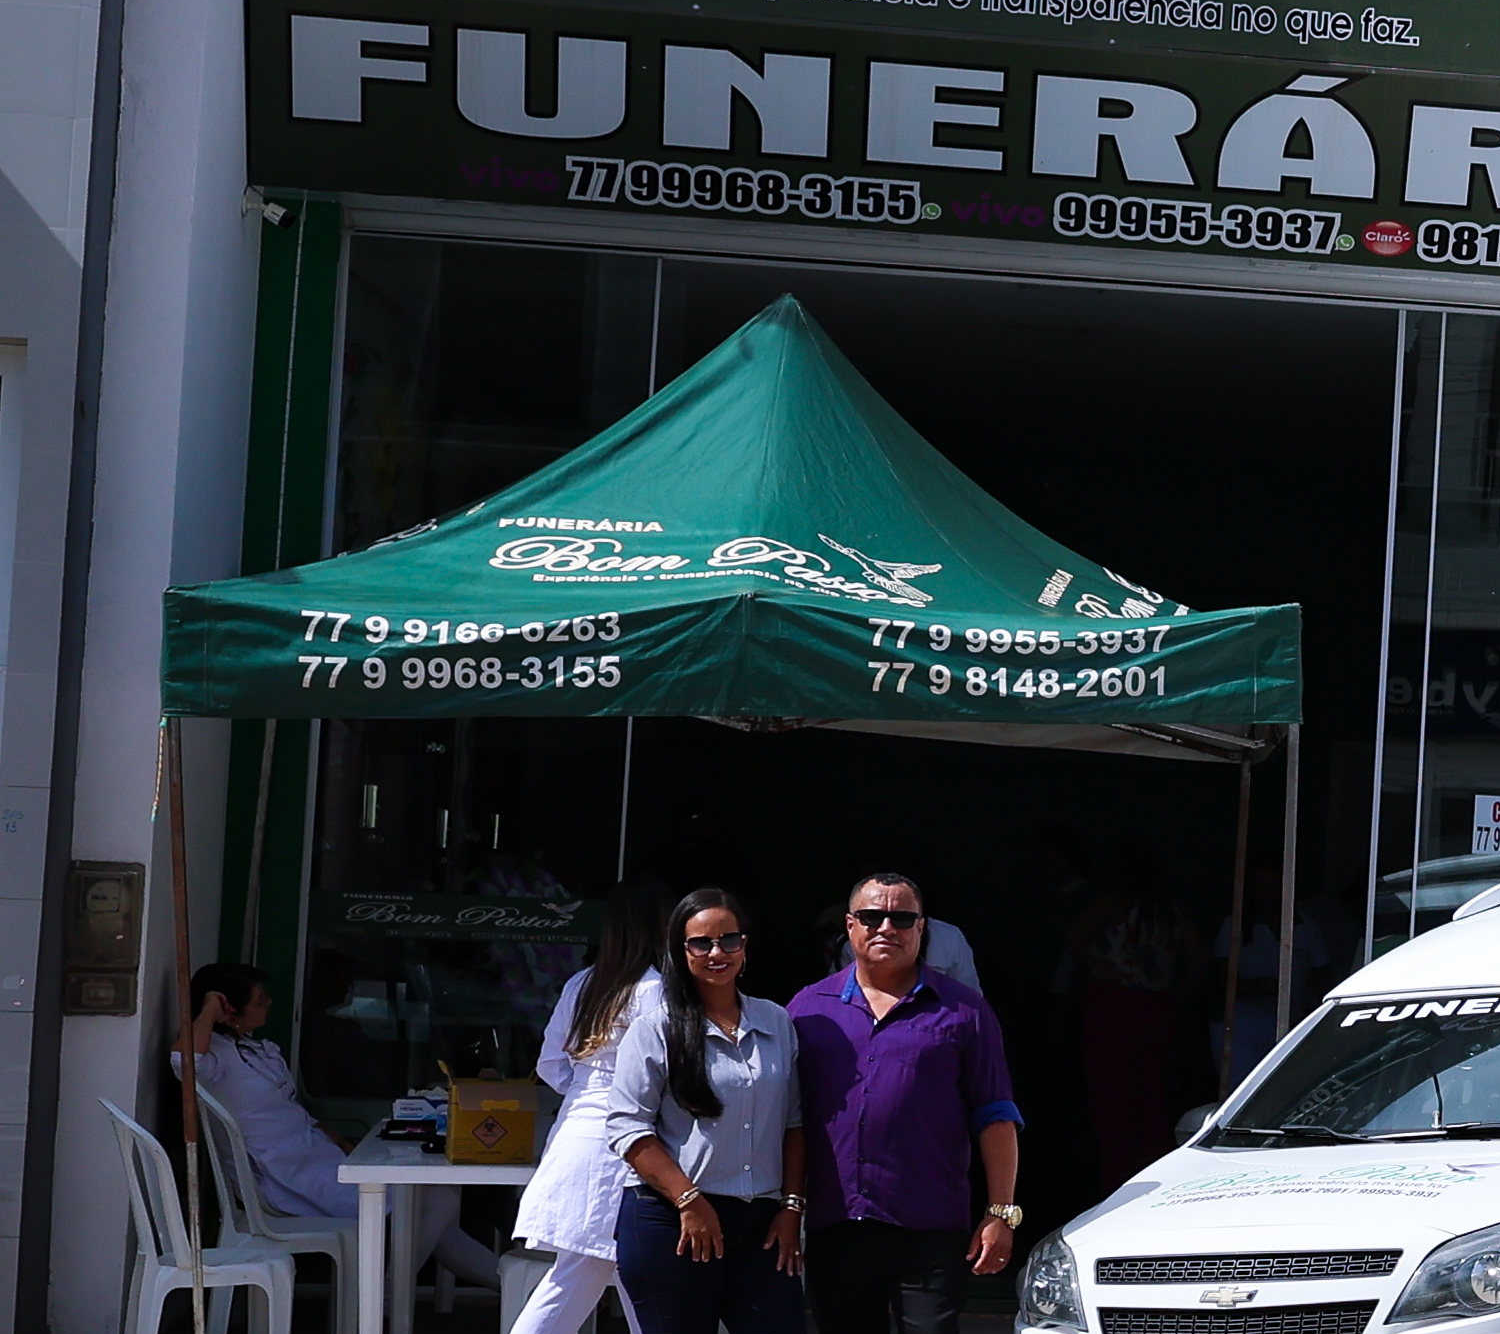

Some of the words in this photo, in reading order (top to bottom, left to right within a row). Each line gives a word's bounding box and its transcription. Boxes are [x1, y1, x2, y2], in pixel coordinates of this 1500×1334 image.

[1230, 0, 1277, 34] no
[1285, 8, 1354, 43] que
[1361, 4, 1420, 47] faz.
[460, 158, 560, 193] vivo
[626, 159, 923, 224] 99968-3155
[951, 192, 1046, 227] vivo
[1053, 193, 1339, 255] 99955-3937
[1365, 230, 1404, 245] Claro
[498, 517, 663, 533] FUNERÁRIA
[489, 535, 690, 572] Bom
[707, 536, 928, 608] Pastor
[301, 609, 351, 642] 77
[364, 615, 389, 644] 9
[868, 618, 914, 650] 77
[928, 623, 952, 652] 9
[965, 624, 1171, 656] 9955-3937
[298, 655, 348, 688] 77
[362, 656, 387, 689] 9
[401, 655, 621, 689] 9968-3155
[868, 661, 913, 694] 77
[928, 664, 952, 696] 9
[965, 665, 1167, 698] 8148-2601
[1476, 826, 1491, 852] 77
[345, 901, 447, 924] Bom
[455, 905, 571, 928] Pastor
